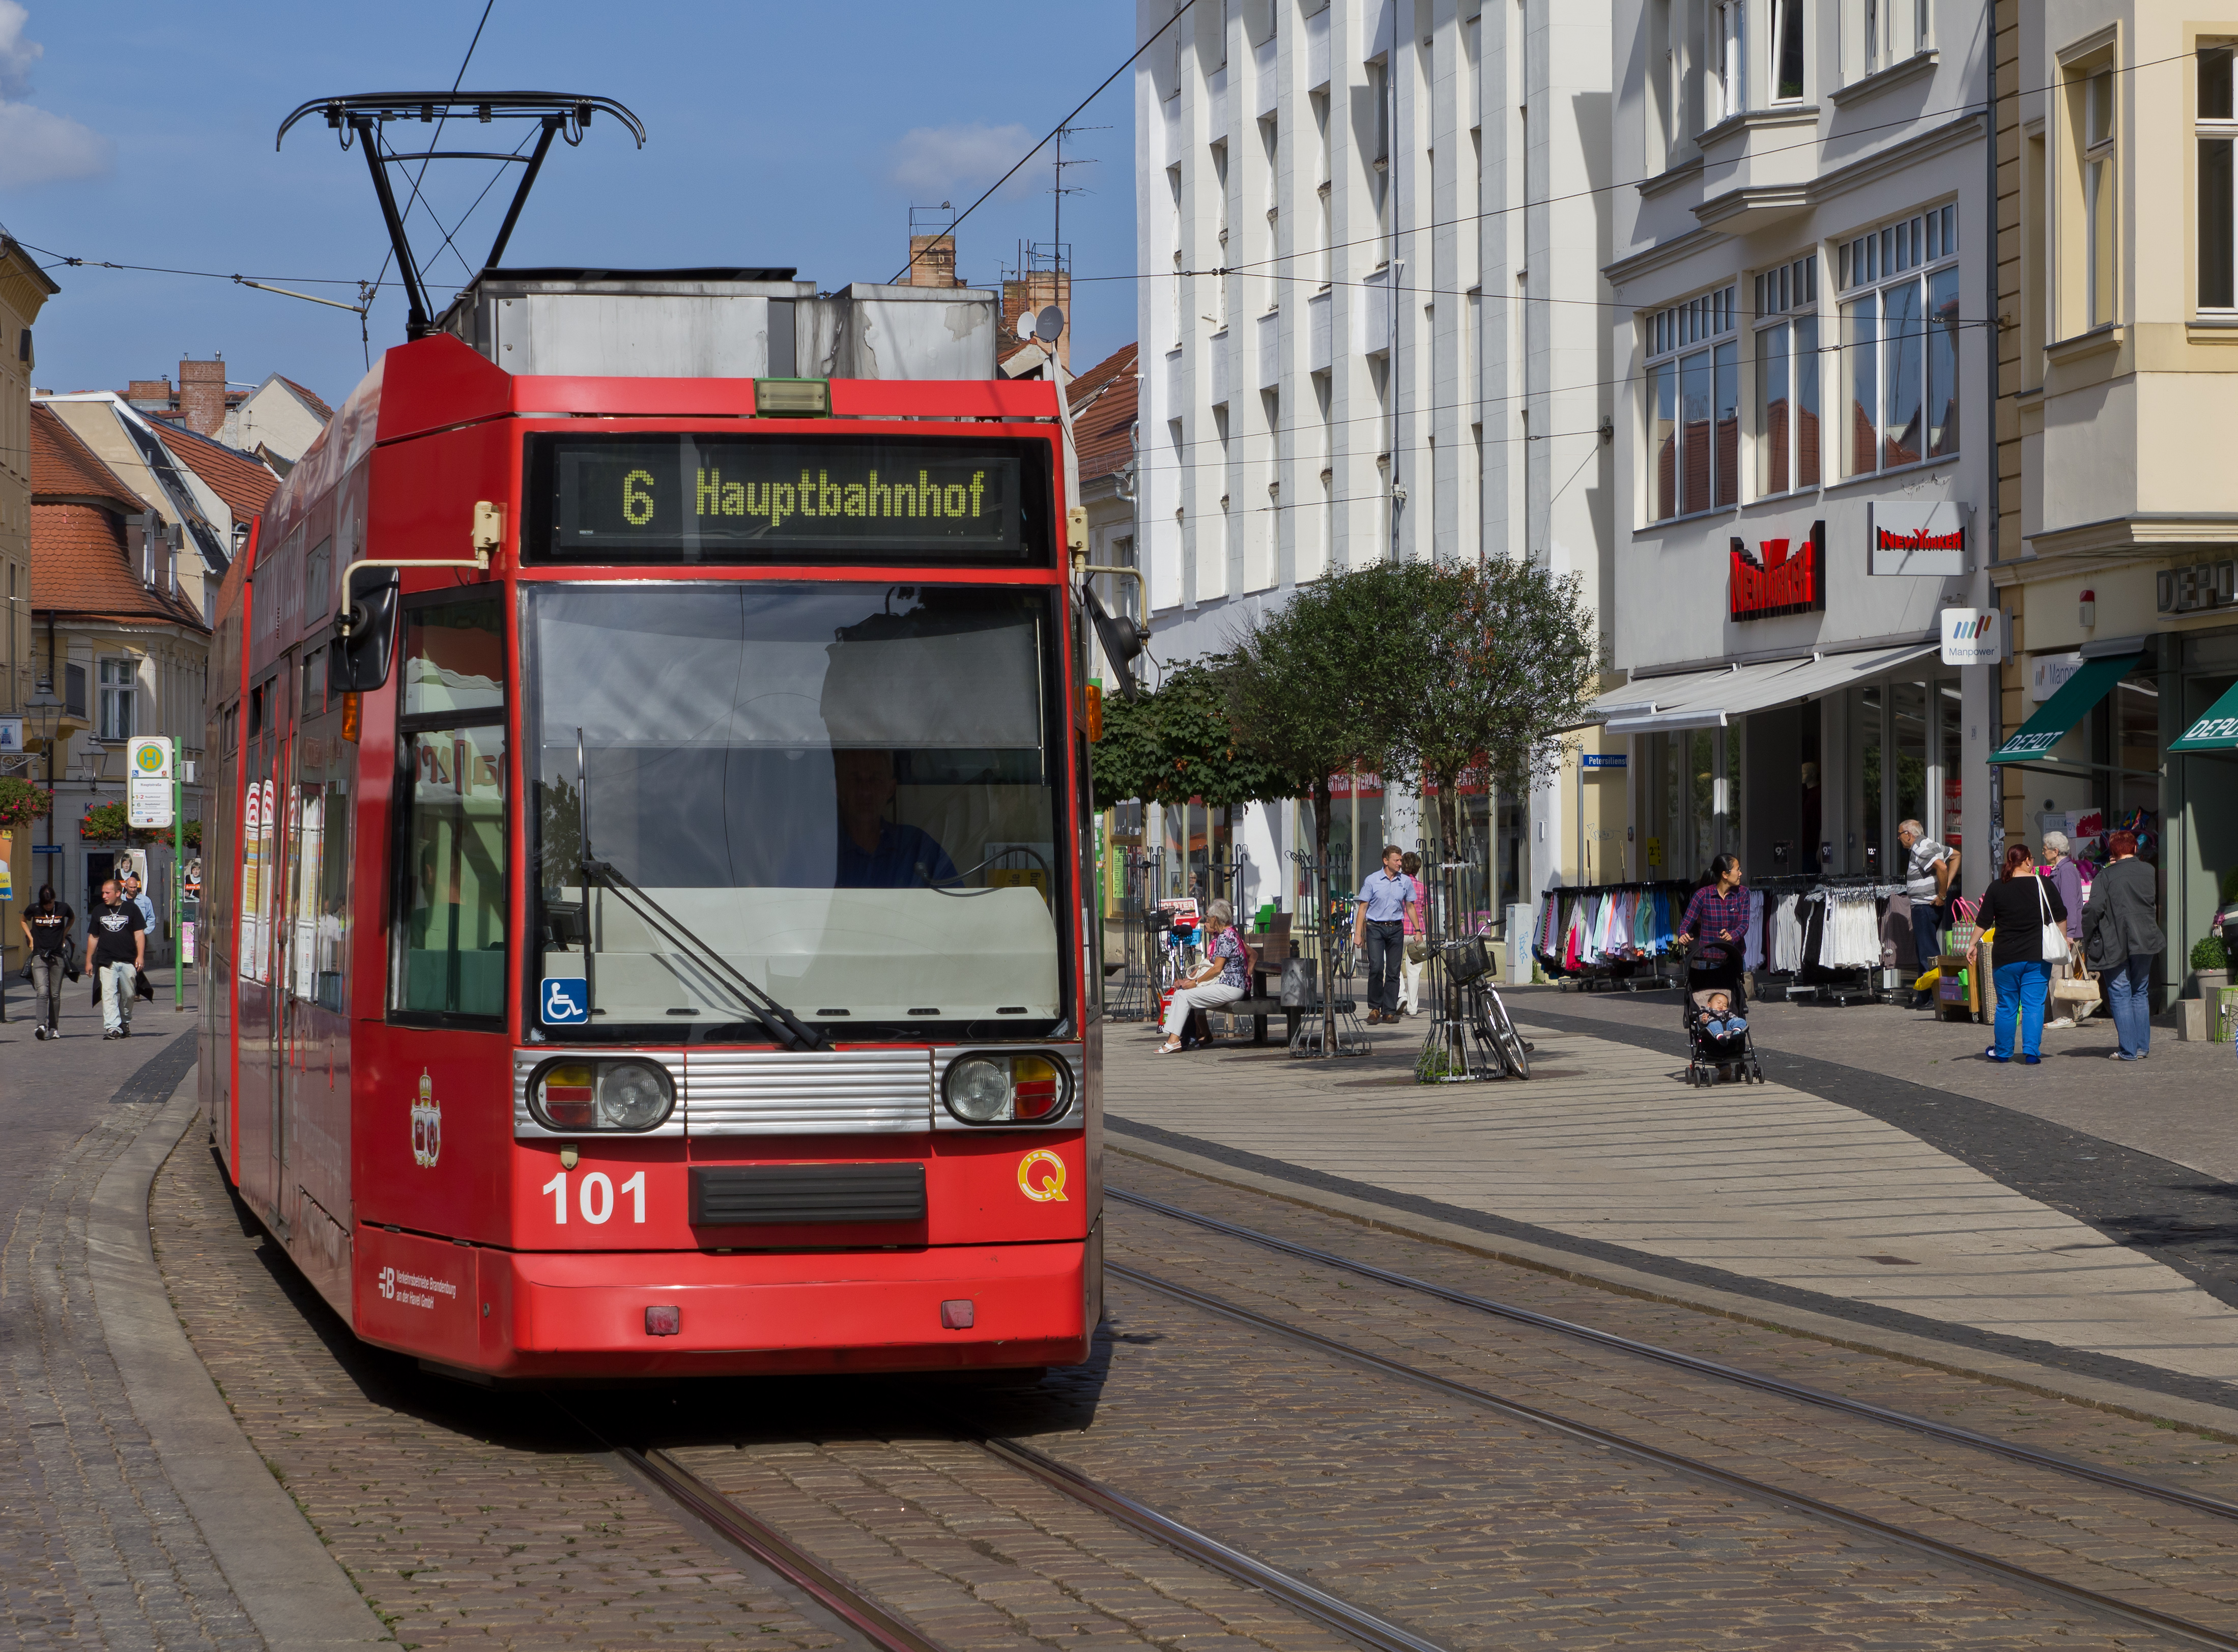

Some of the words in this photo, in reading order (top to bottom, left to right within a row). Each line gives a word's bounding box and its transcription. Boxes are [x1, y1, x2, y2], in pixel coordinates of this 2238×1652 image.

[623, 470, 654, 525] 6
[696, 468, 985, 527] Hauptbahnhof
[2156, 559, 2238, 613] DEPO
[1949, 647, 1995, 658] Manpower
[2049, 663, 2081, 685] Manpow
[2001, 731, 2064, 751] DEPOT
[2185, 718, 2238, 738] DEPO
[1017, 1149, 1069, 1203] Q
[542, 1171, 646, 1225] 101
[396, 1269, 429, 1290] Verkehrsbetriebe
[429, 1277, 456, 1299] Brandenburg
[396, 1291, 402, 1301] an
[409, 1291, 421, 1306] Havel
[421, 1293, 434, 1309] GmbH
